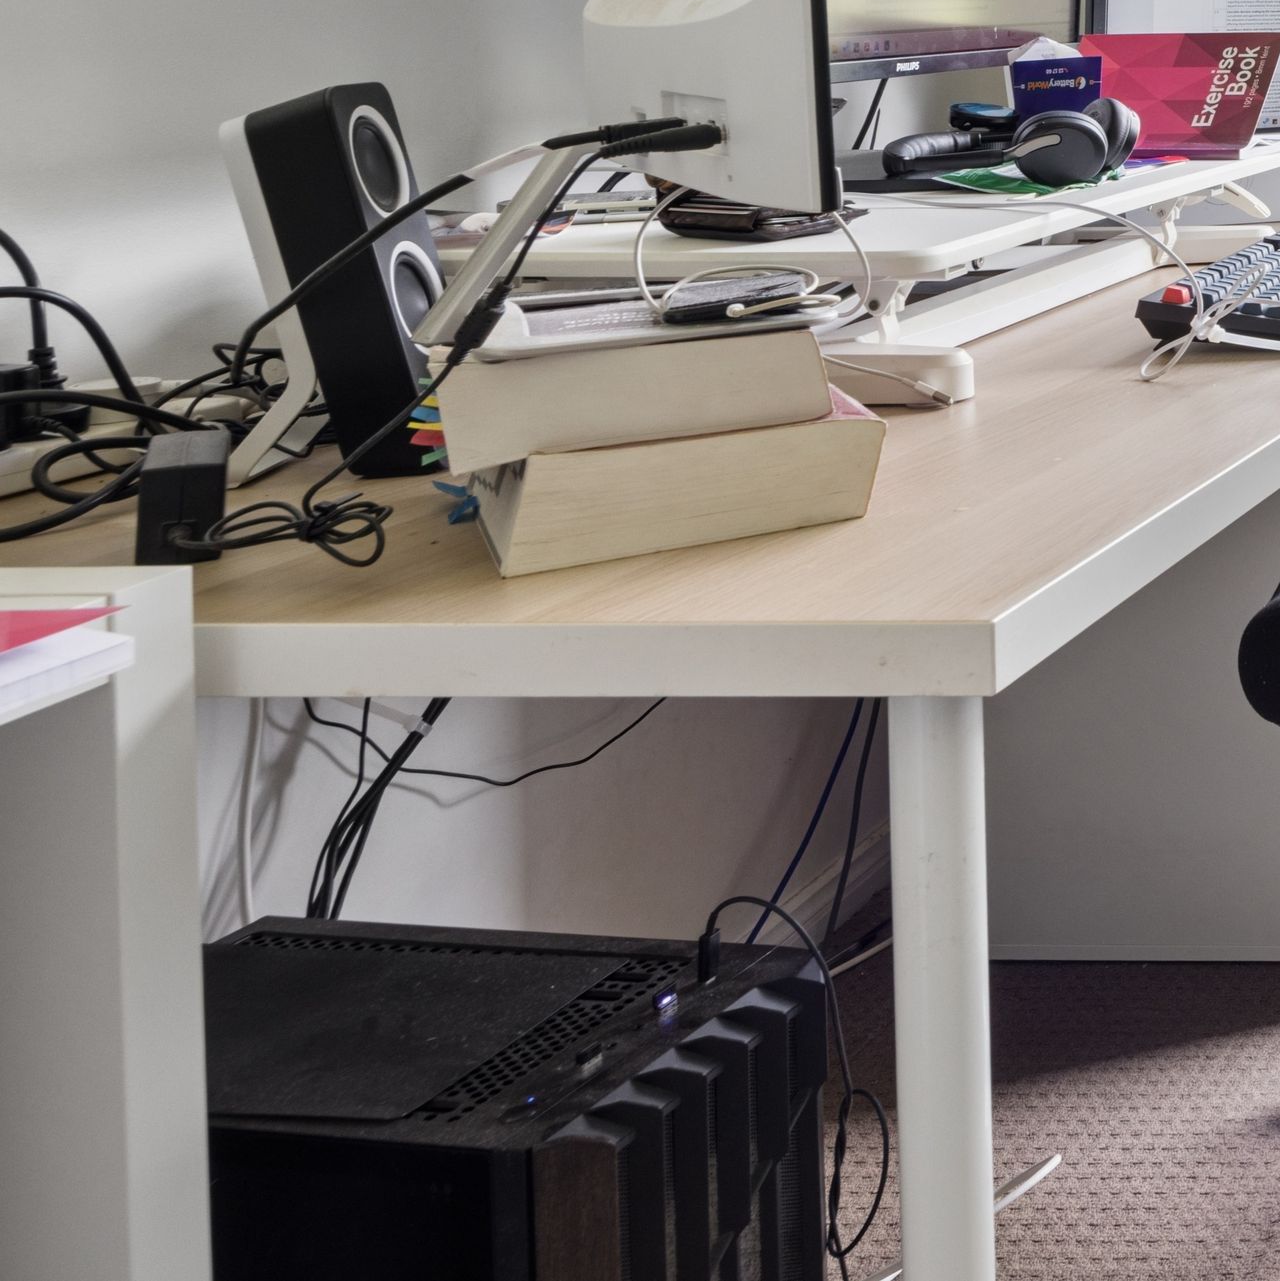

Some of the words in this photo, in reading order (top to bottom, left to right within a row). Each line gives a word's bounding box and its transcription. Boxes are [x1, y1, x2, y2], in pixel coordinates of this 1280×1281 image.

[896, 61, 920, 72] PHILIPS
[1225, 46, 1261, 95] Book
[1191, 46, 1238, 127] Exercise
[1243, 96, 1254, 108] 192
[1249, 78, 1259, 96] pages
